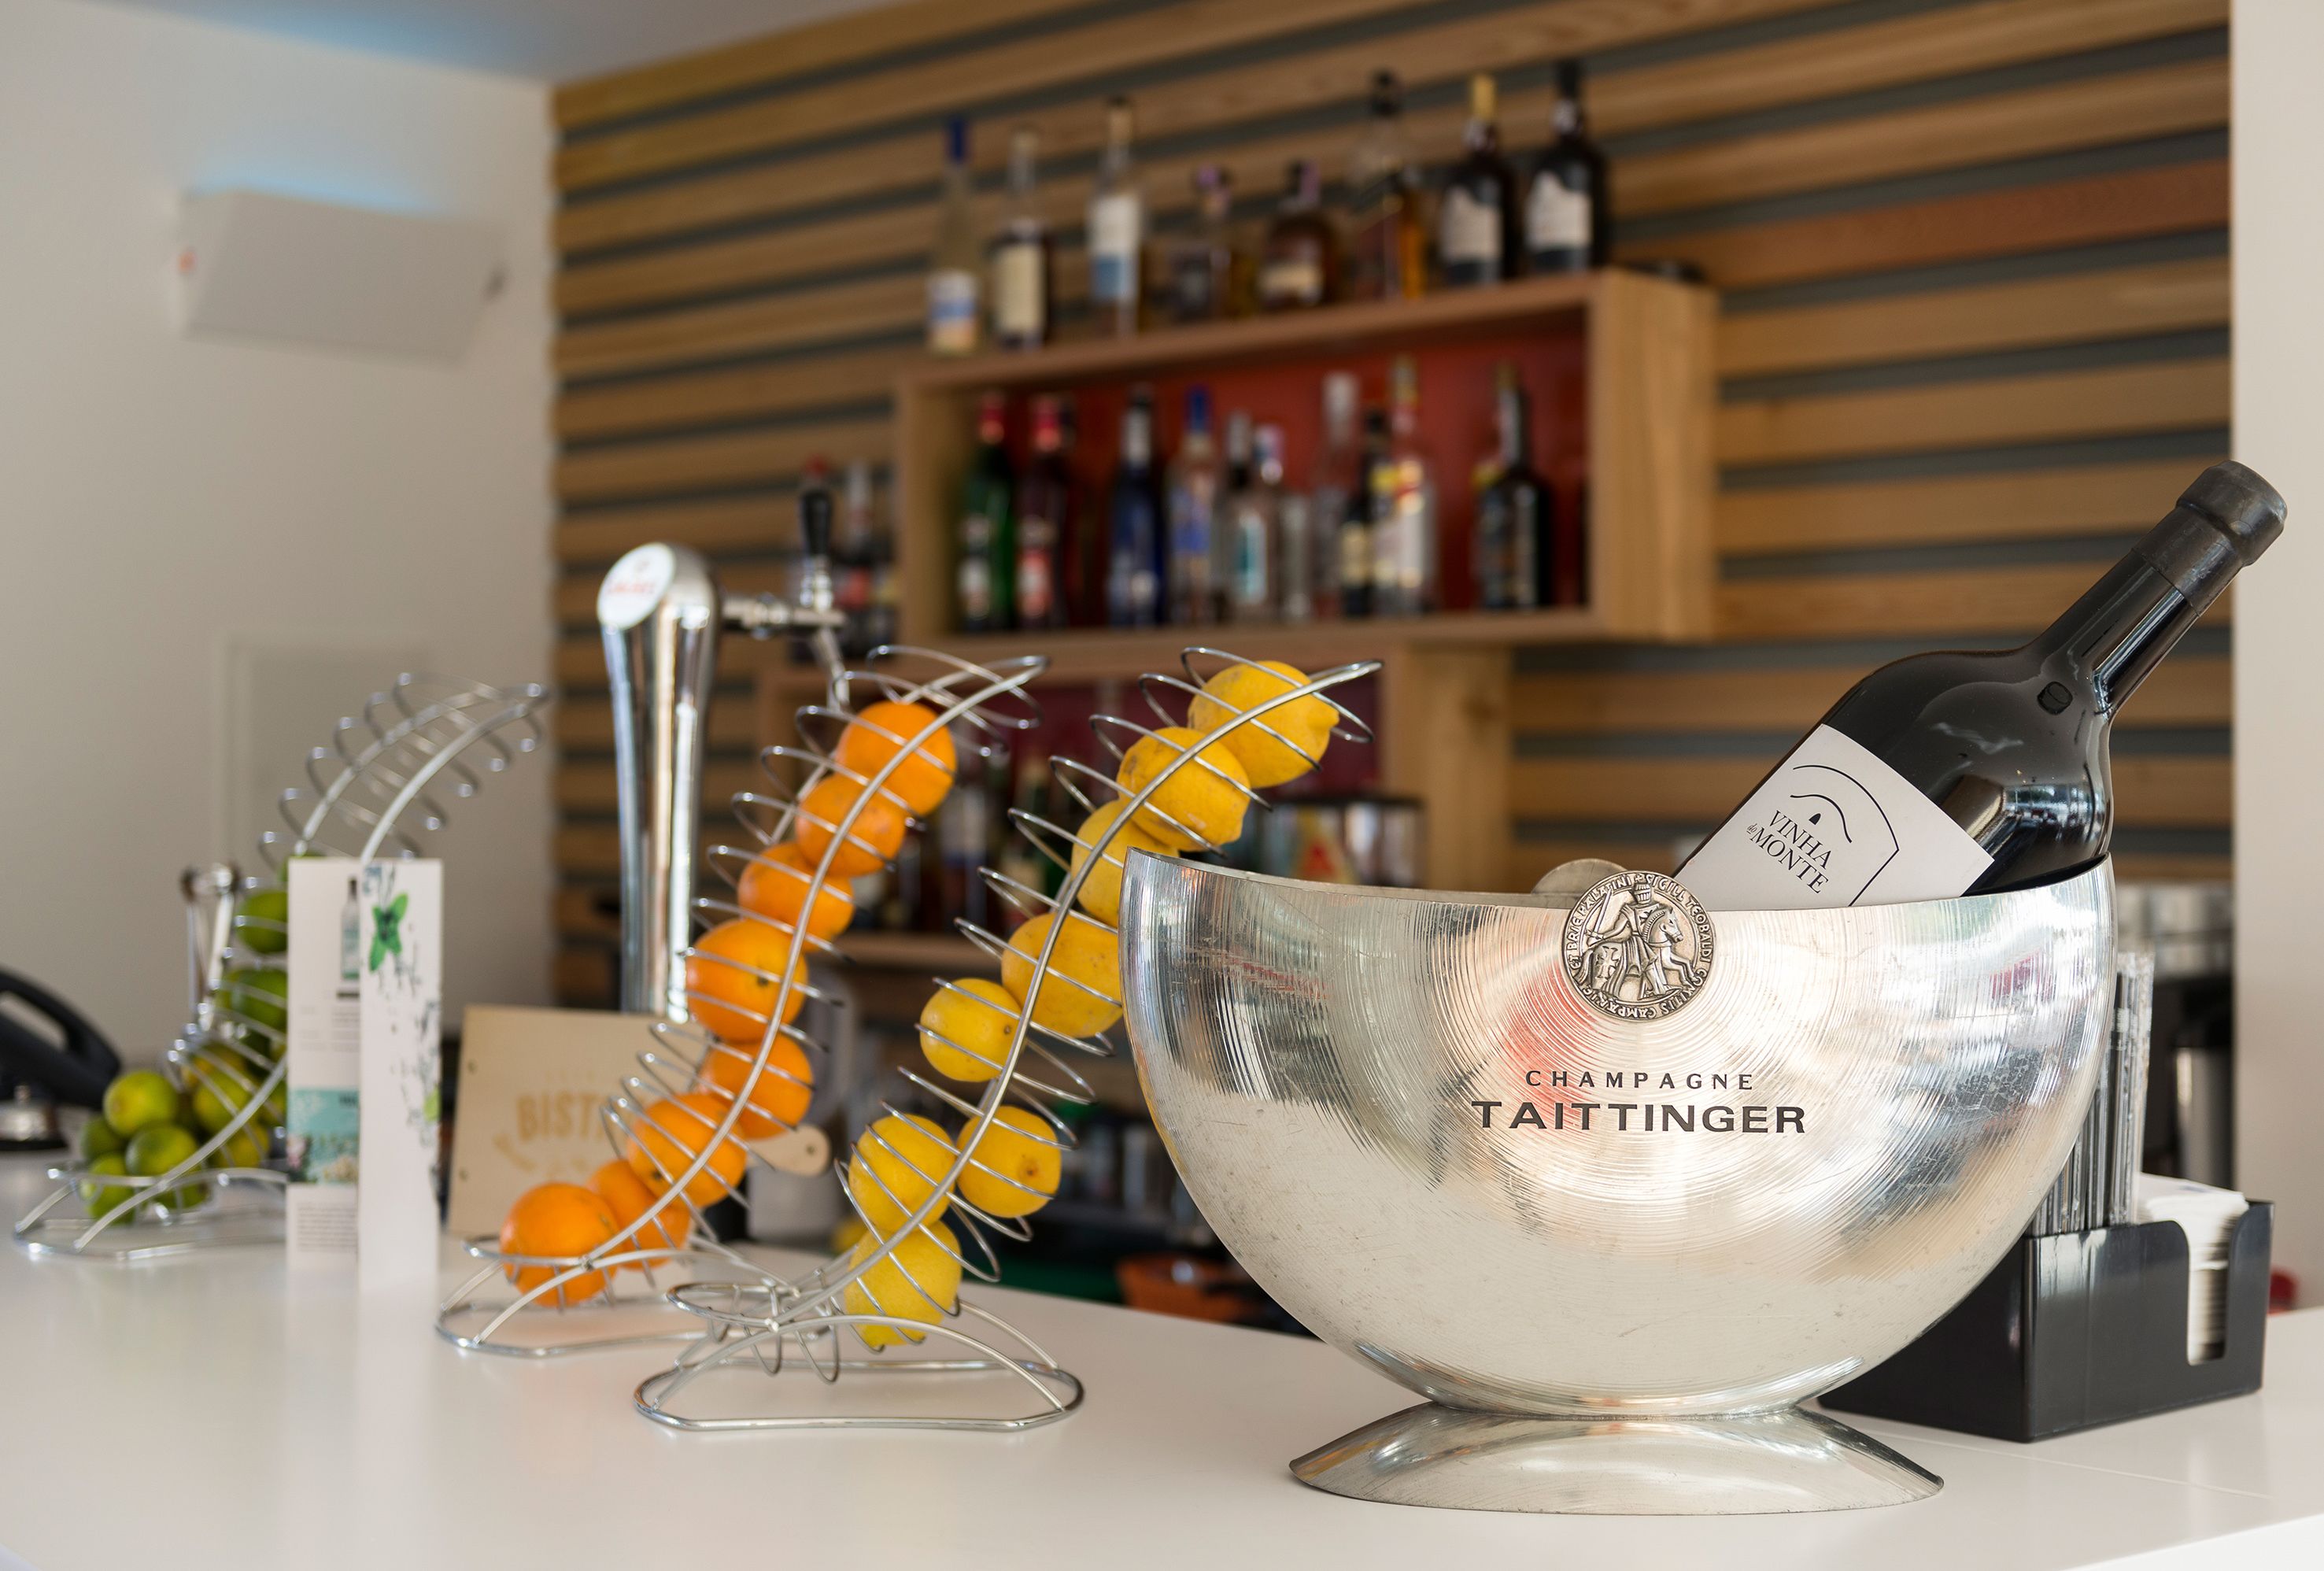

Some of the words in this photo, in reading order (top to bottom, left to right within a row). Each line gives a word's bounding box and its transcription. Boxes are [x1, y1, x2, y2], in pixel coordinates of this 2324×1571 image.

[1750, 827, 1829, 894] MONTE
[1769, 810, 1831, 870] VINHA
[1525, 1070, 1753, 1090] CHAMPAGNE
[1471, 1101, 1805, 1133] TAITTINGER
